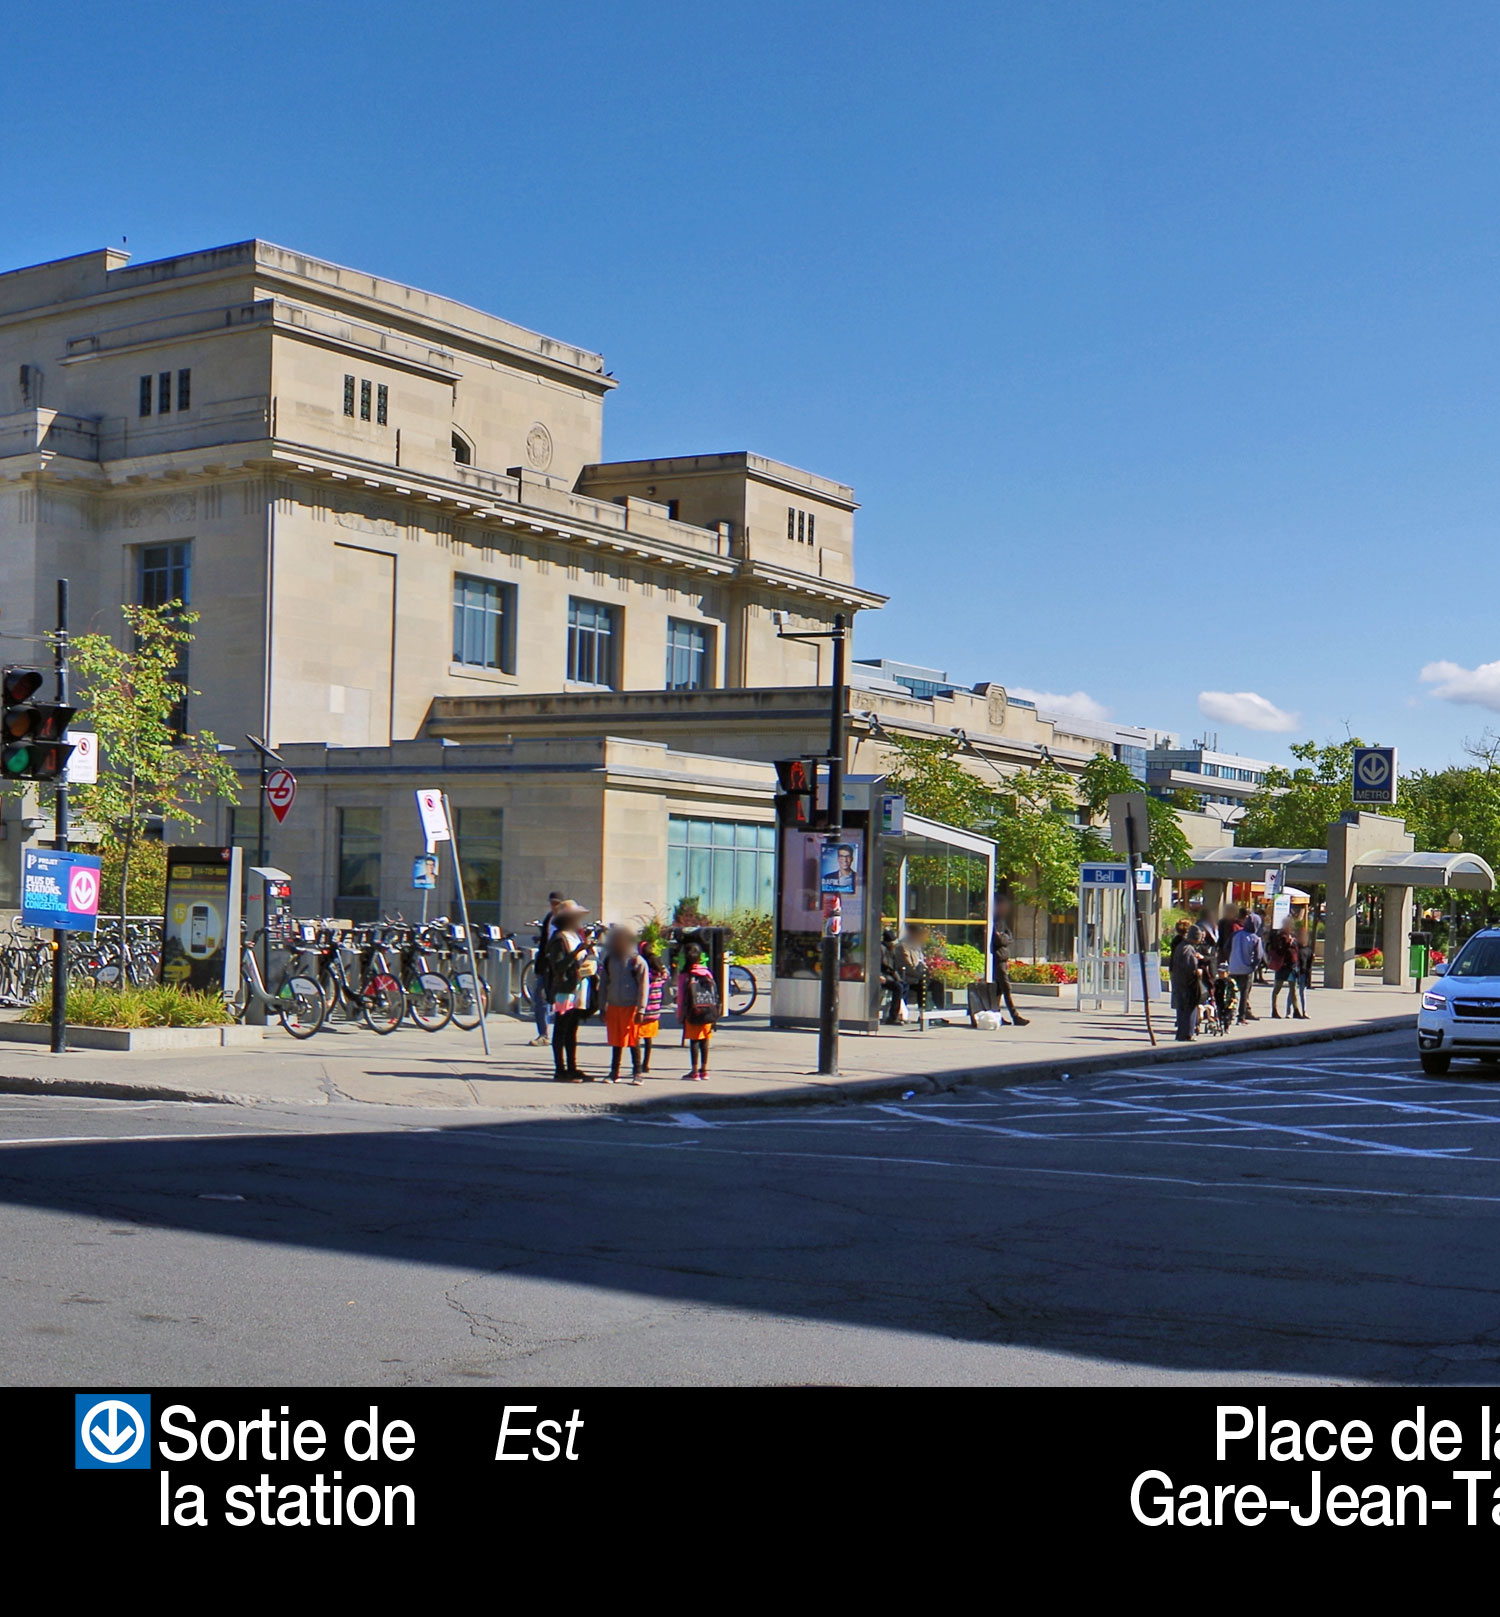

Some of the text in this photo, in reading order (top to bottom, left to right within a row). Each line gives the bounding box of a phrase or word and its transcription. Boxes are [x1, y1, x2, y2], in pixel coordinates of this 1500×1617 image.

[26, 874, 56, 886] PLUS DE
[1095, 870, 1115, 882] Bell
[25, 892, 59, 903] MOINS DE
